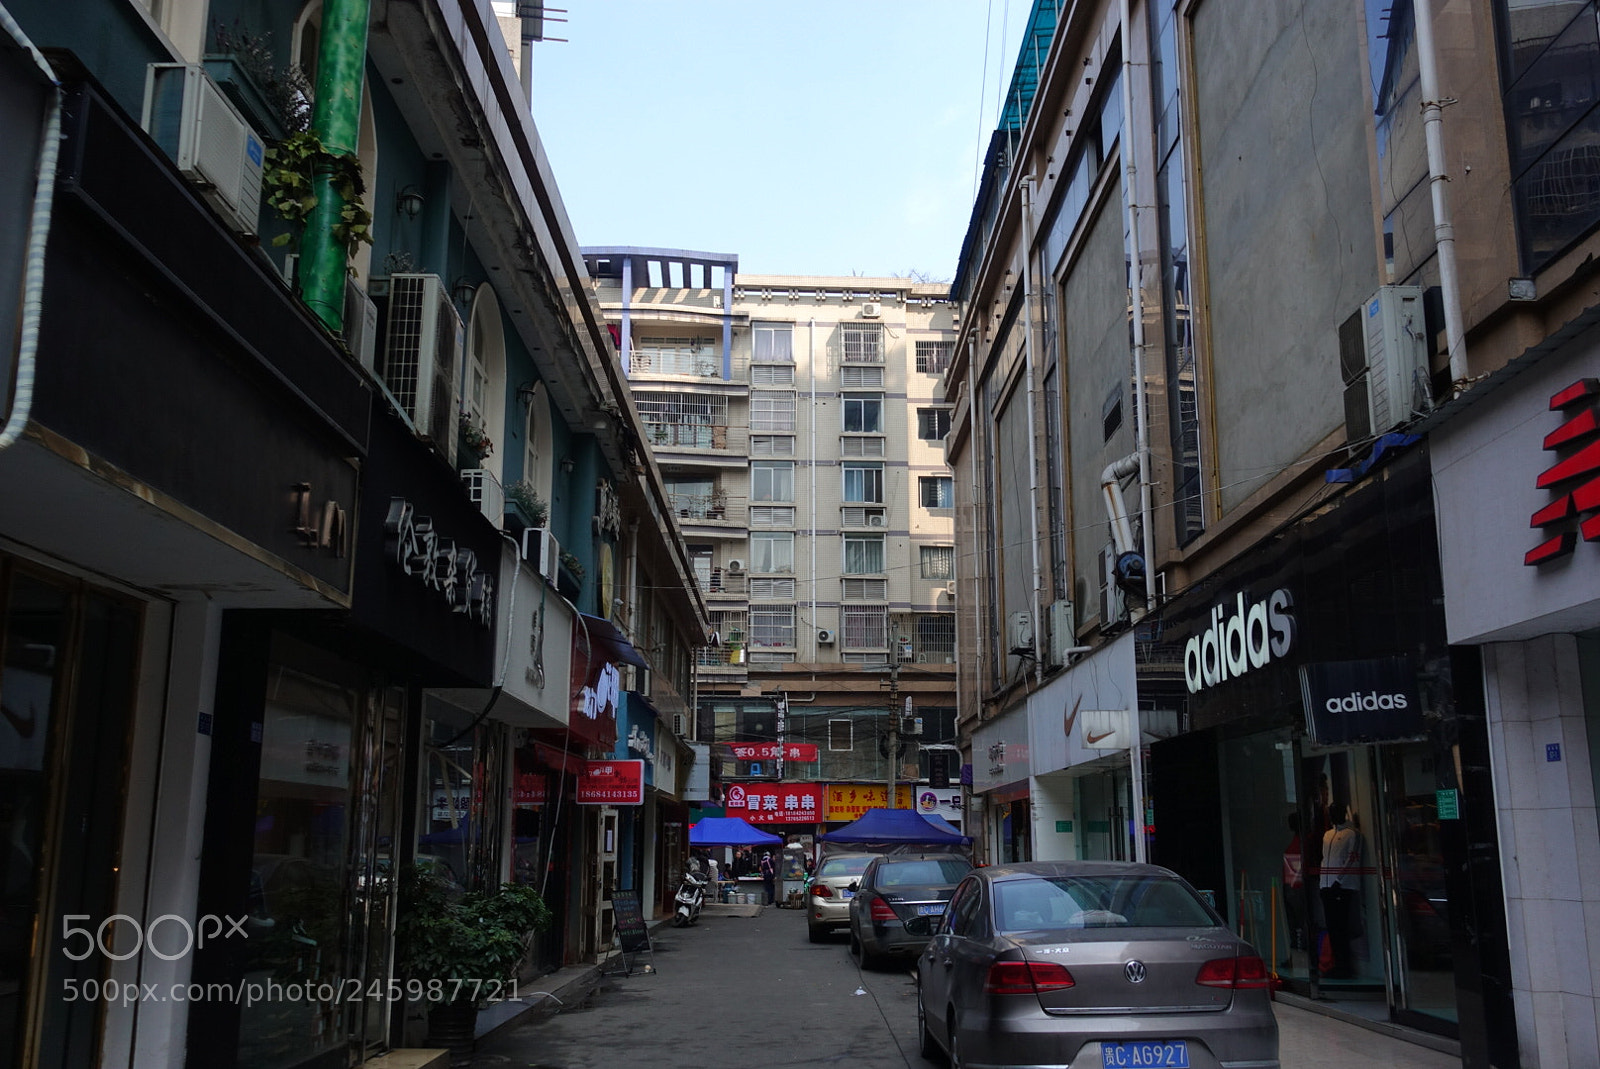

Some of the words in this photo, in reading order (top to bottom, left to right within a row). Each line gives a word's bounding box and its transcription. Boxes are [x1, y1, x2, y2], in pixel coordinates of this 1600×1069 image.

[1184, 588, 1297, 694] adidas
[1325, 690, 1408, 714] adidas
[746, 793, 779, 811] 冒菜
[784, 793, 816, 811] 串串
